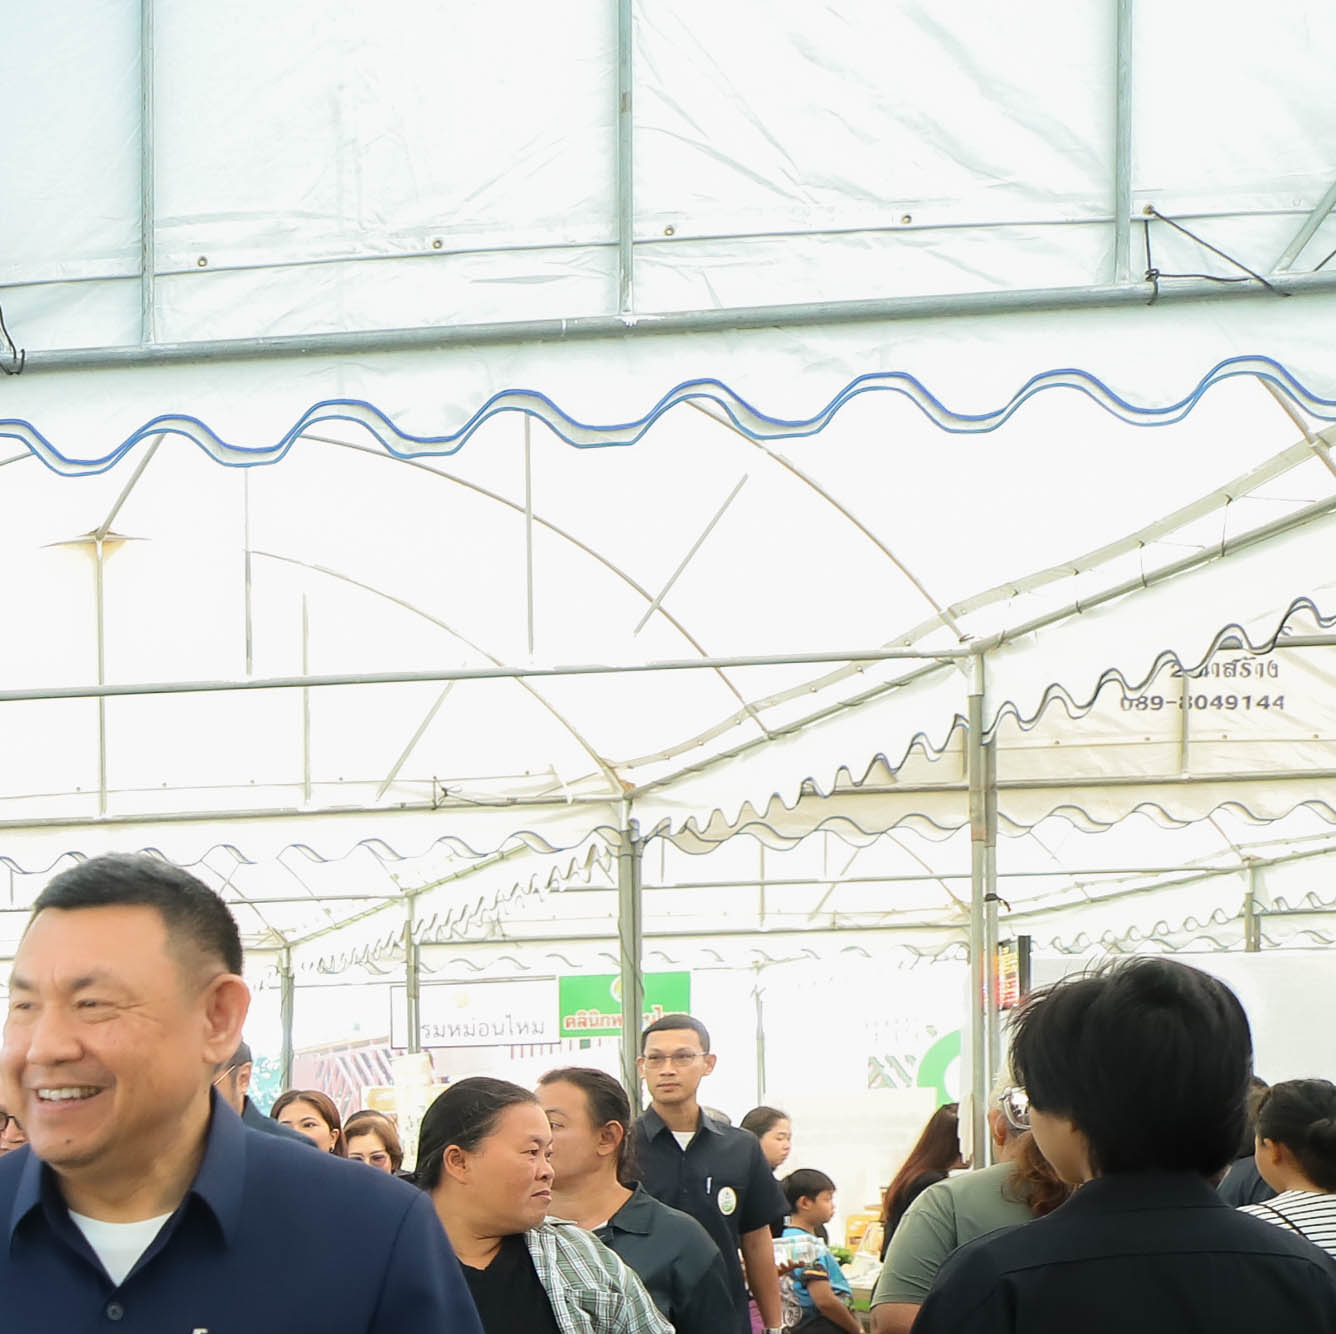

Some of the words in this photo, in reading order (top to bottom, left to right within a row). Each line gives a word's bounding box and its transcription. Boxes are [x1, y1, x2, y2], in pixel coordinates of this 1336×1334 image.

[1120, 695, 1285, 710] 089-8049144
[420, 1013, 545, 1039] รมหม่อนไหม
